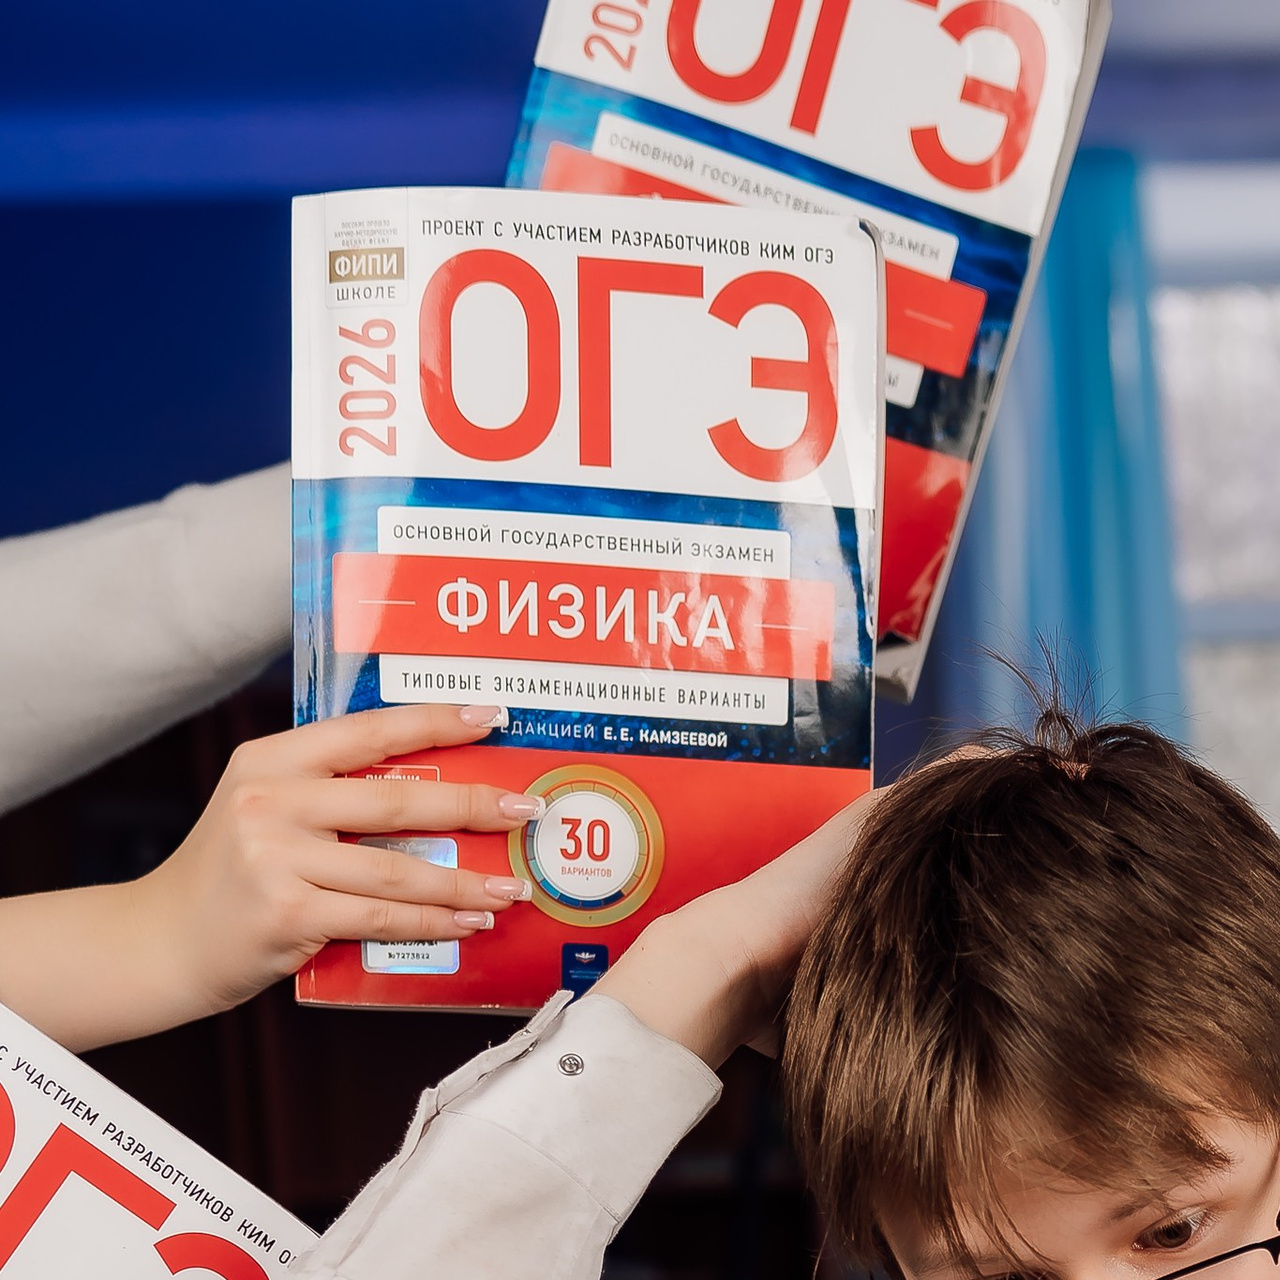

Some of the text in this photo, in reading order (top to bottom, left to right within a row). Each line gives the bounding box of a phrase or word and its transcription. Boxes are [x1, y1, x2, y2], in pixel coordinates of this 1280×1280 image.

[584, 0, 649, 72] 20
[421, 219, 834, 264] ПРОЕКТ С УЧАСТИЕМ РАЗРАБОТЧИКОВ КИМ ОГЭ
[334, 253, 398, 278] ФИПИ
[336, 286, 396, 301] ШКОЛЕ
[338, 318, 397, 457] 2026
[419, 248, 839, 482] ОГЭ
[393, 522, 774, 563] ОСНОВНОЙ ГОСУДАРСТВЕННЫЙ ЭКЗАМЕН
[437, 577, 735, 651] ФИЗИКА
[402, 671, 766, 710] ТИПОВЫЕ ЭКЗАМЕНАЦИОННЫЕ ВАРИАНТЫ
[639, 728, 728, 748] КАМЗЕЕВОЙ
[560, 817, 610, 862] 30
[561, 866, 612, 878] ВАРИАНТОВ
[11, 1056, 100, 1127] УЧАСТИЕМ
[102, 1121, 235, 1224] РАЗРАБОТЧИКОВ
[236, 1218, 276, 1253] КИМ
